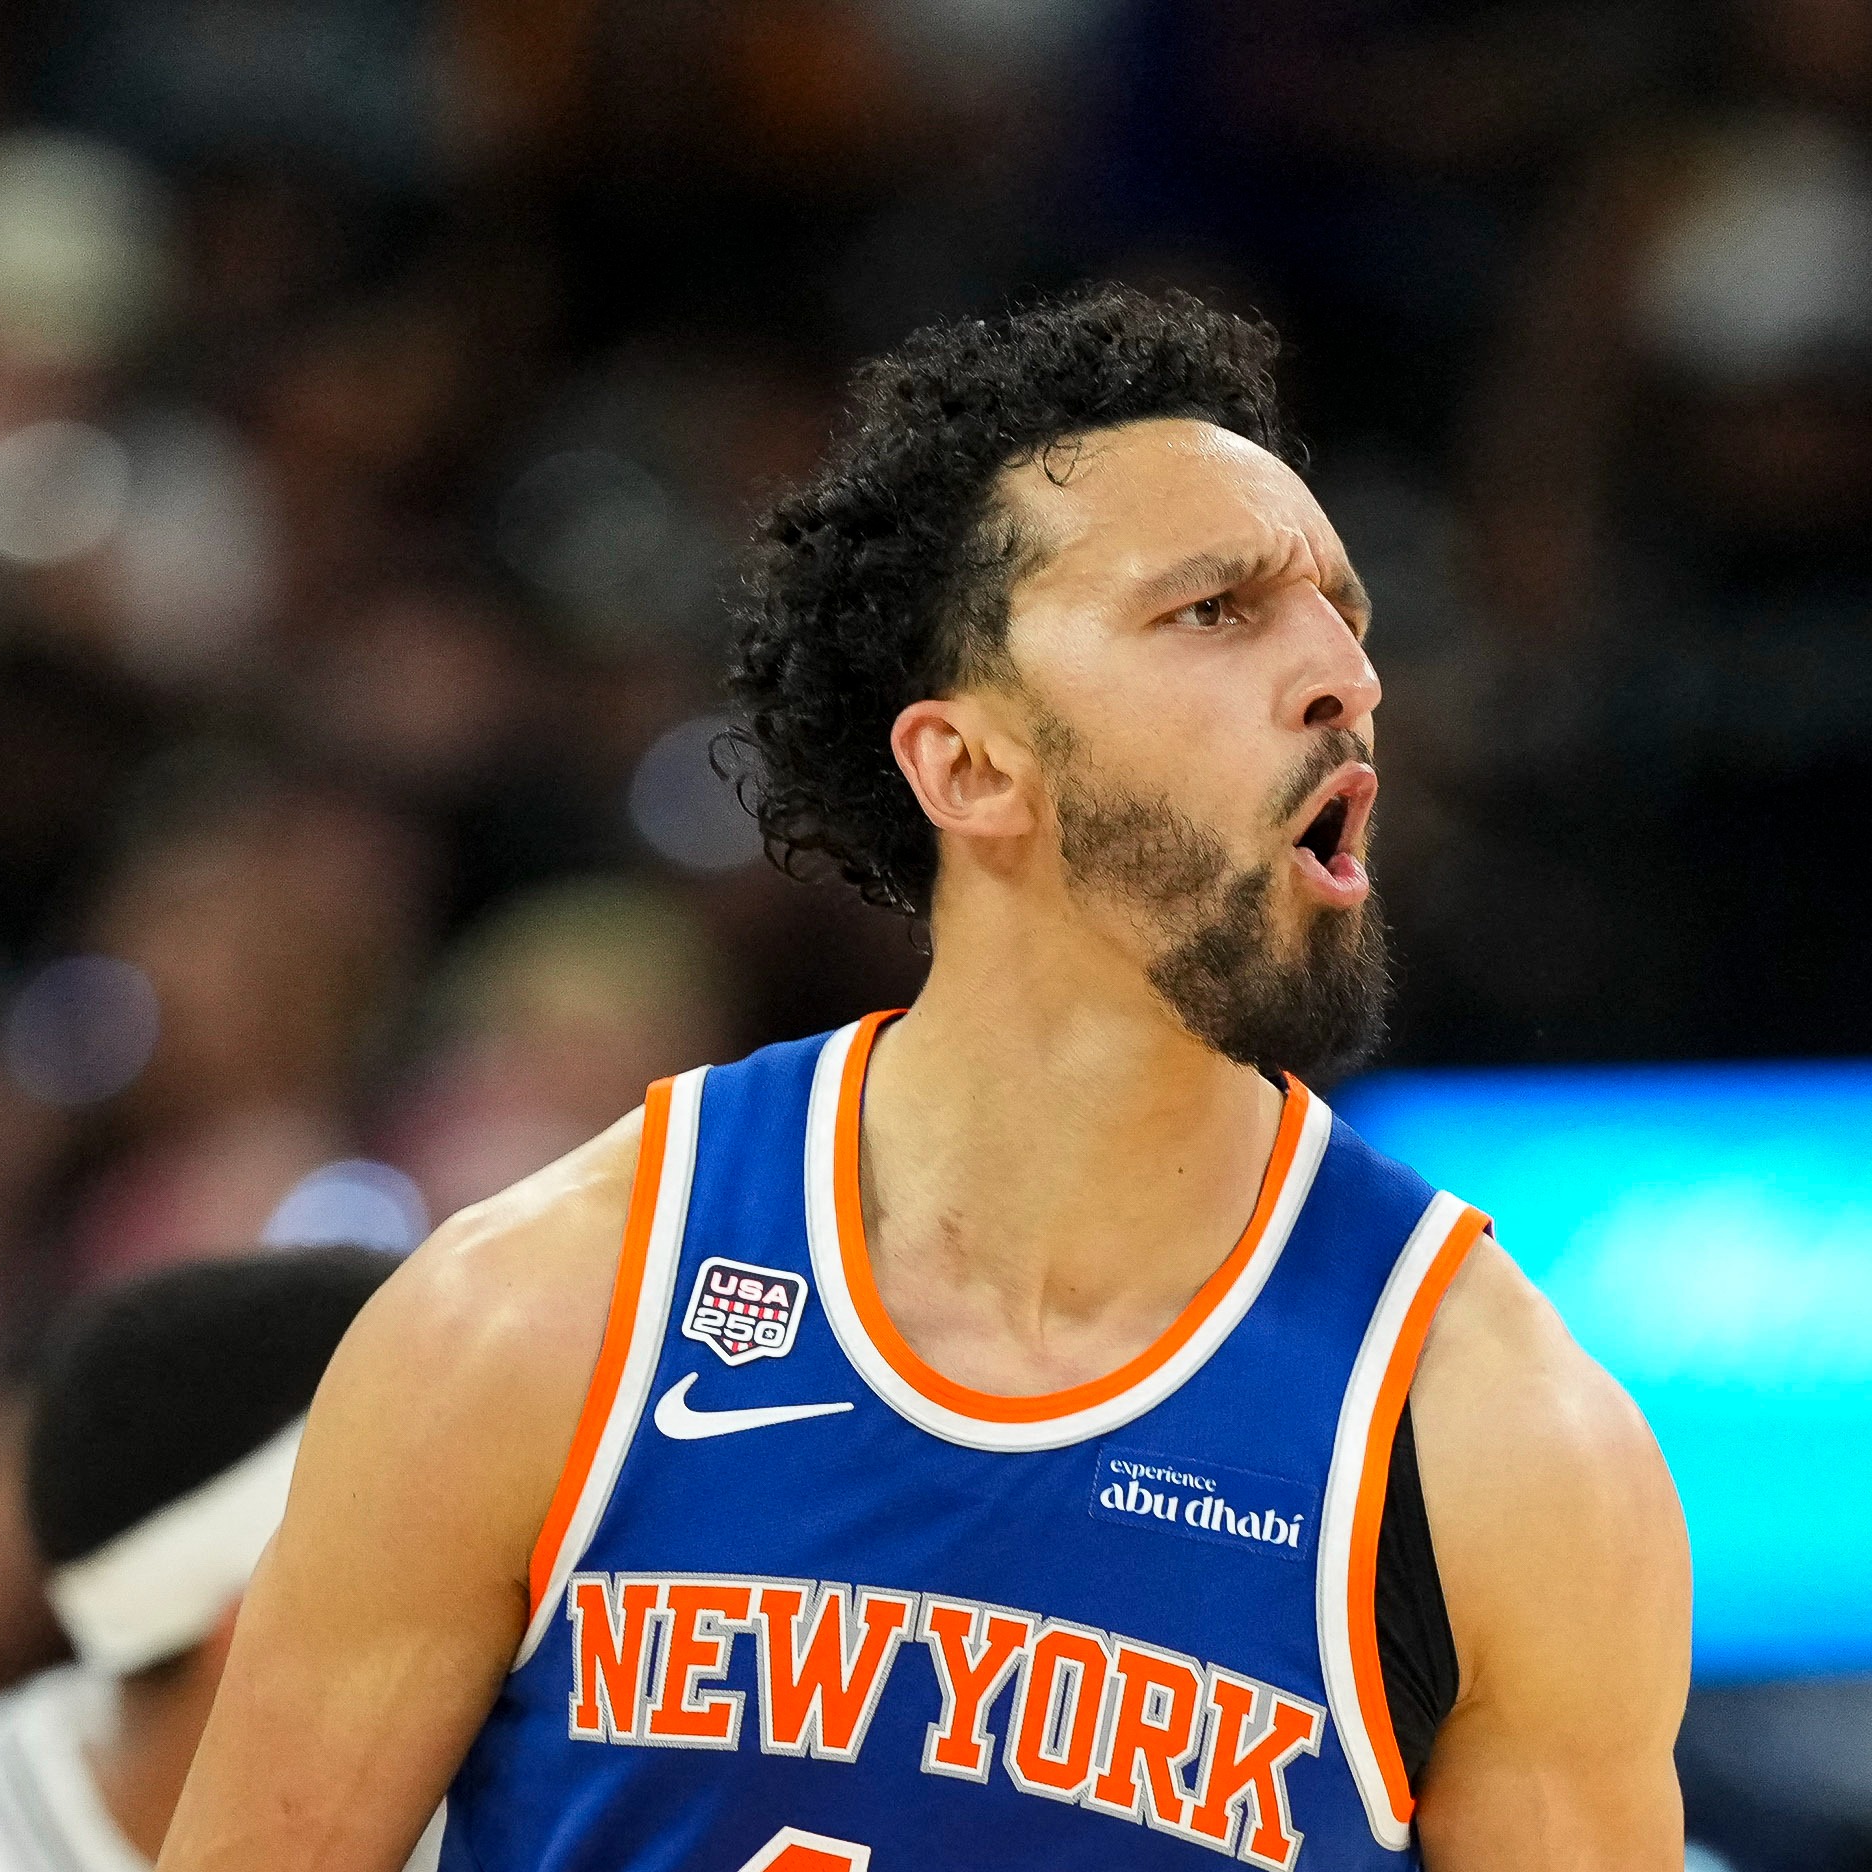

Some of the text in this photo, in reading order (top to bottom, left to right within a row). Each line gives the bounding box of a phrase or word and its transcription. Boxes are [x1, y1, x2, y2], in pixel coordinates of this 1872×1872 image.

[710, 1271, 790, 1308] USA
[692, 1306, 786, 1348] 250
[1110, 1459, 1217, 1492] experience
[1100, 1480, 1304, 1548] abu dhabi
[569, 1573, 921, 1757] NEW
